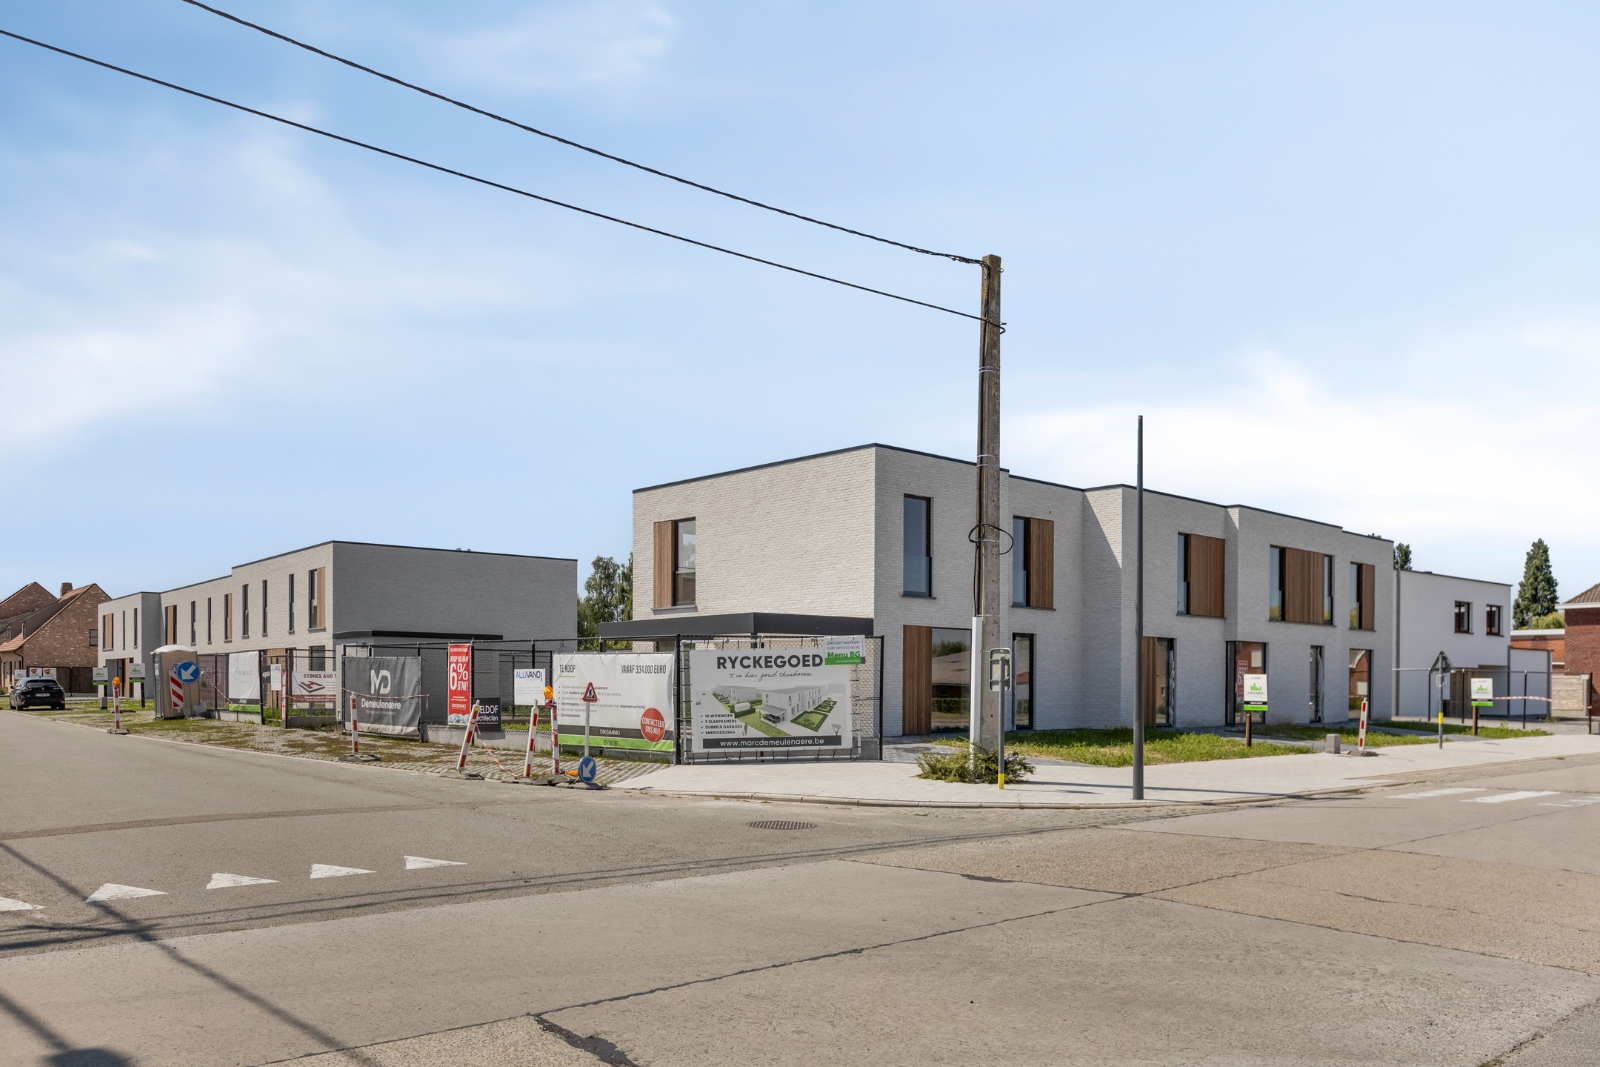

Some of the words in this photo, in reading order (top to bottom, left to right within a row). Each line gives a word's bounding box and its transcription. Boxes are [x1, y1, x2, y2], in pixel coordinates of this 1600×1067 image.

[716, 654, 824, 670] RYCKEGOED
[654, 664, 666, 674] EURO
[450, 663, 468, 690] 6%
[758, 670, 778, 682] goed
[361, 698, 401, 709] Demeulenaere
[720, 738, 824, 747] www.marcdemeulenaere.be
